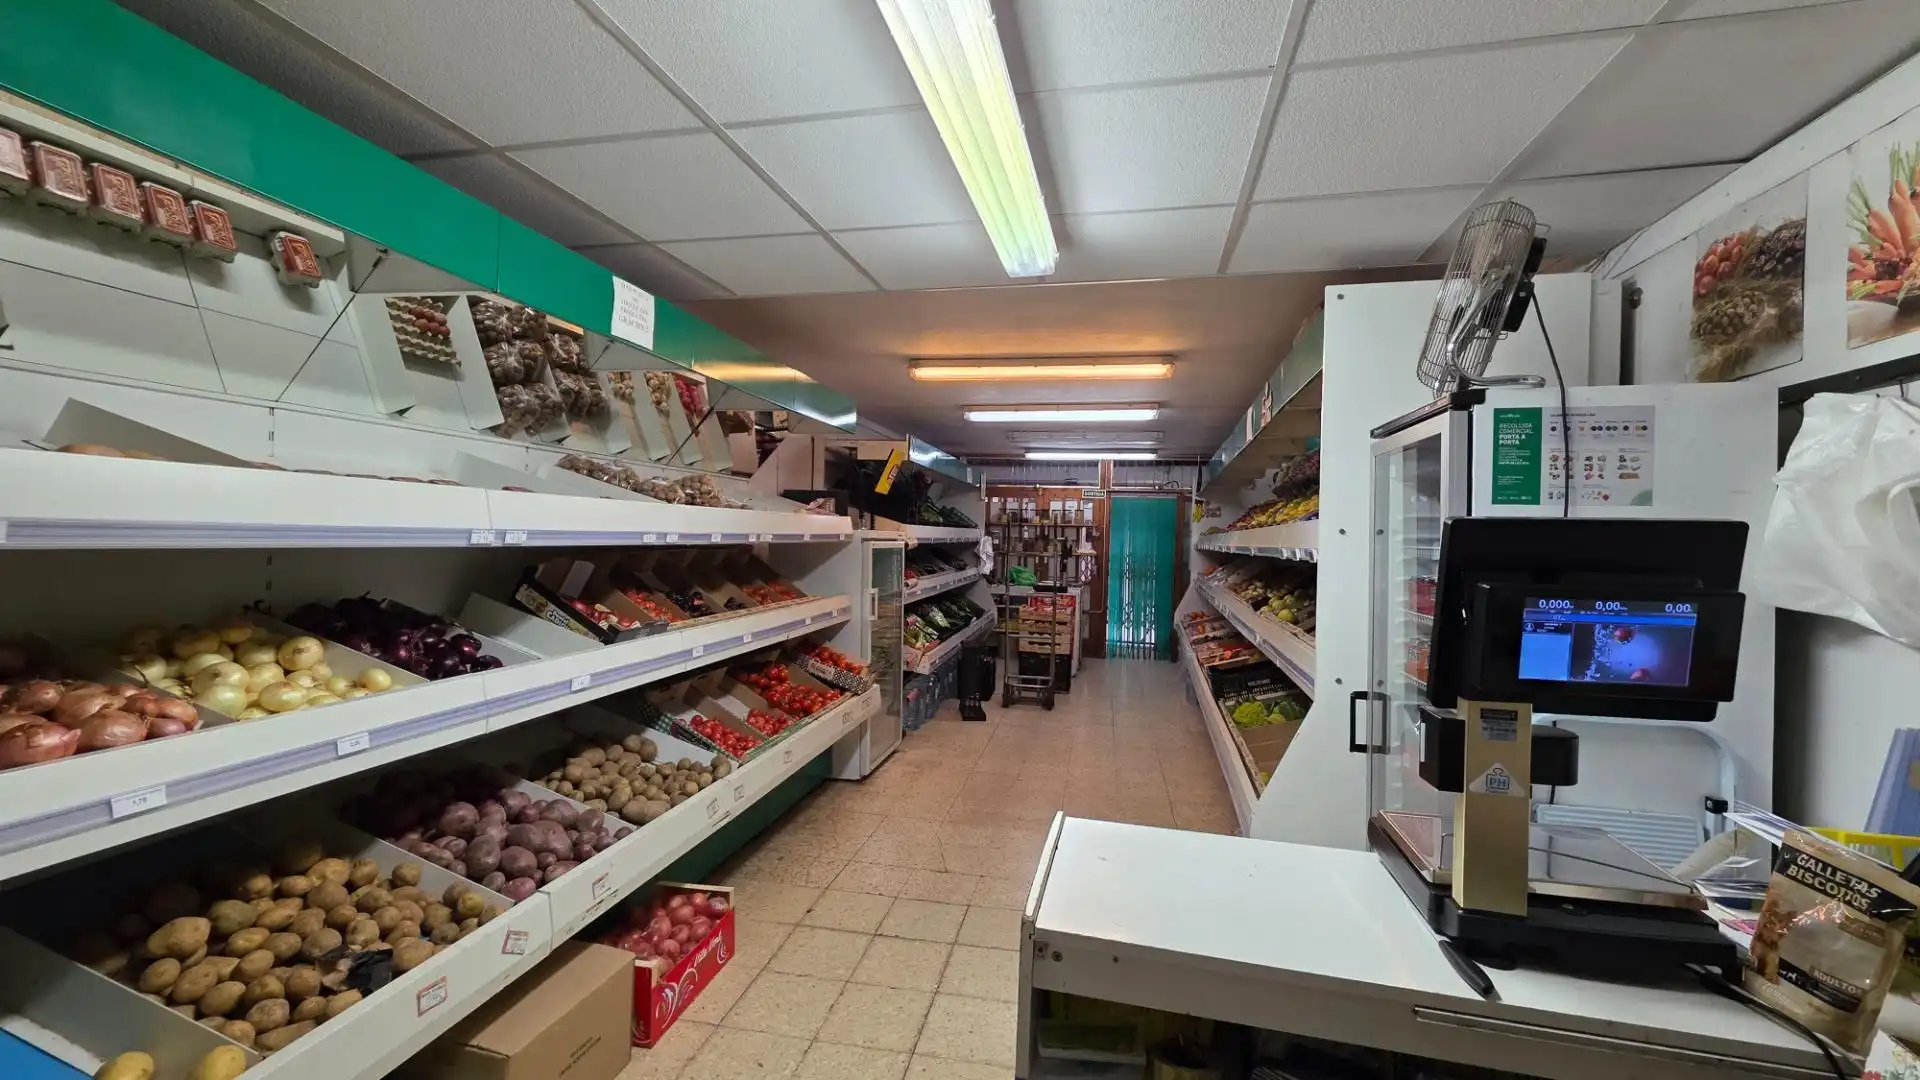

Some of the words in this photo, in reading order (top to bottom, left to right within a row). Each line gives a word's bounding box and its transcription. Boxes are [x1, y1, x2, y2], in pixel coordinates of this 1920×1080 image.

[1539, 599, 1570, 609] 0,000
[1596, 601, 1621, 611] 0,00
[1665, 603, 1690, 613] 0,00
[1787, 865, 1870, 910] BISCOITOS
[1796, 854, 1881, 898] GALLETAS
